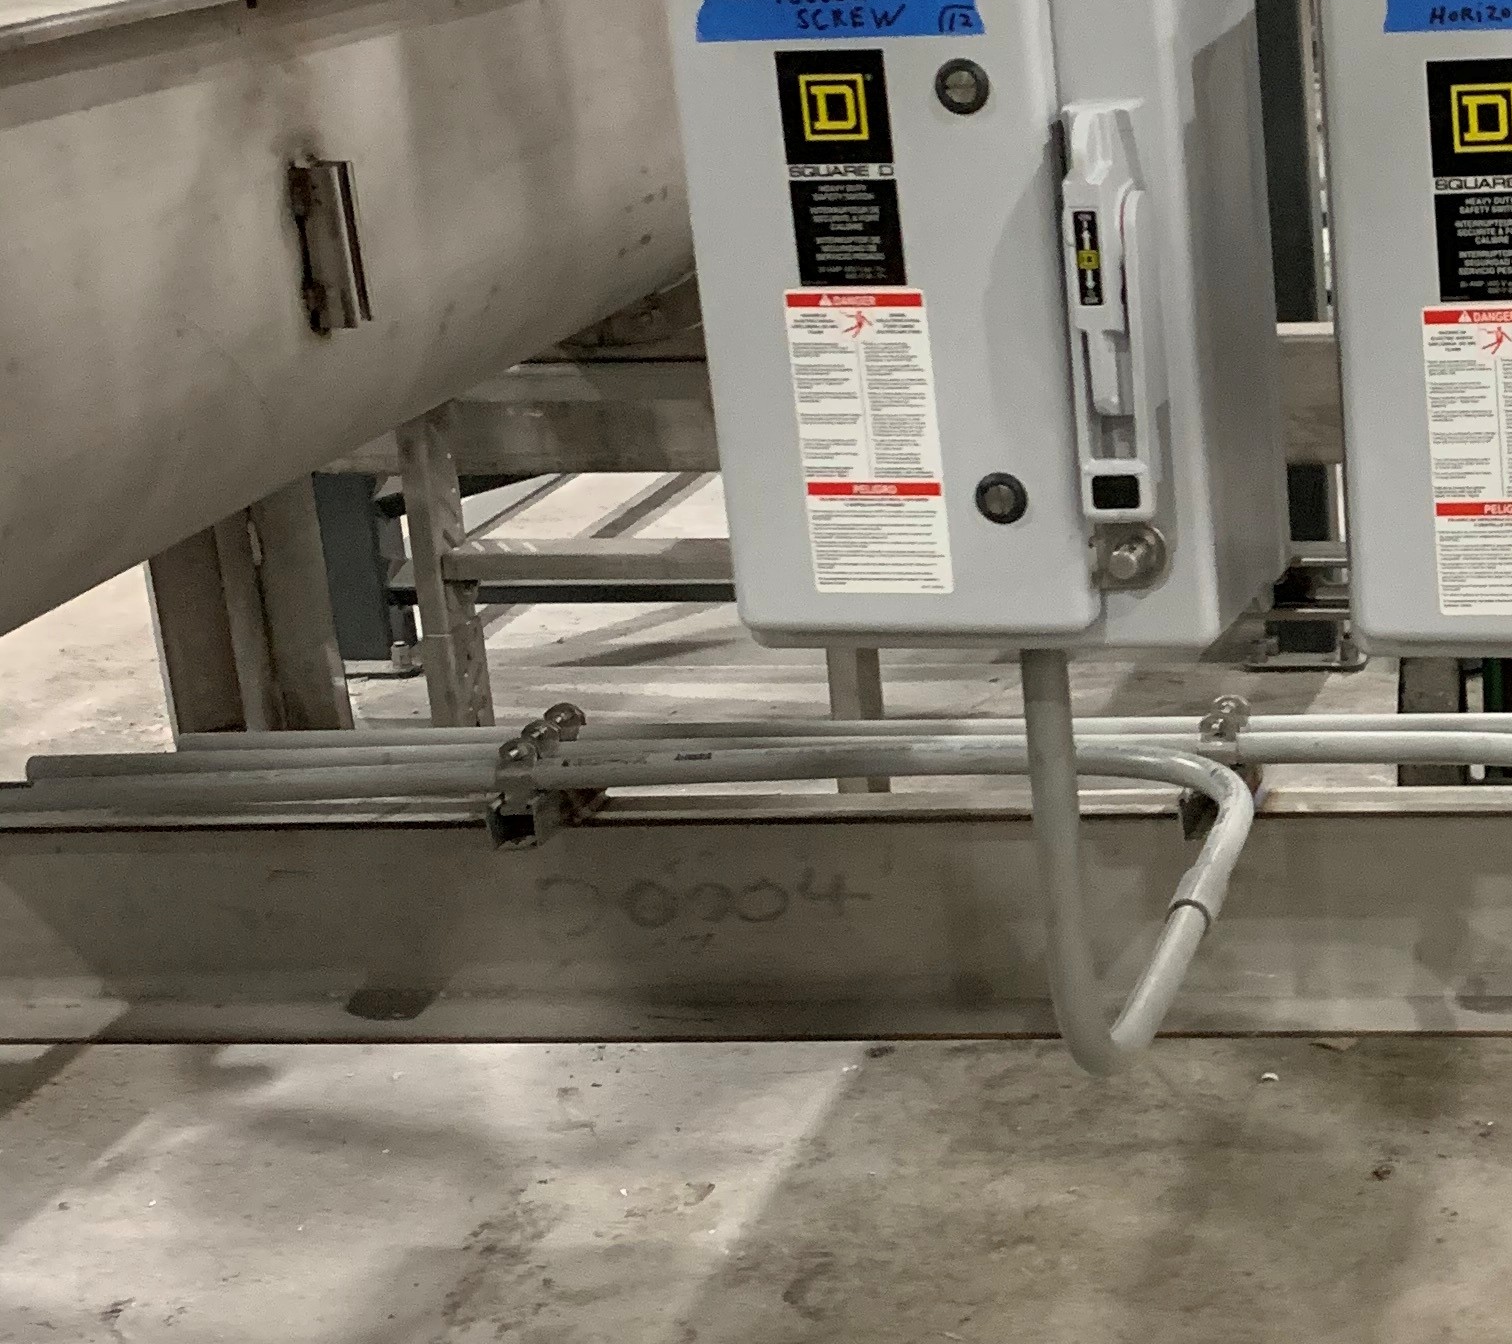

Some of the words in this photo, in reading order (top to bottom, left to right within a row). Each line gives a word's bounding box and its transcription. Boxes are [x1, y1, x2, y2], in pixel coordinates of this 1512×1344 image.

[797, 4, 906, 31] SCREW
[789, 165, 869, 177] SQUARE
[878, 164, 894, 176] D
